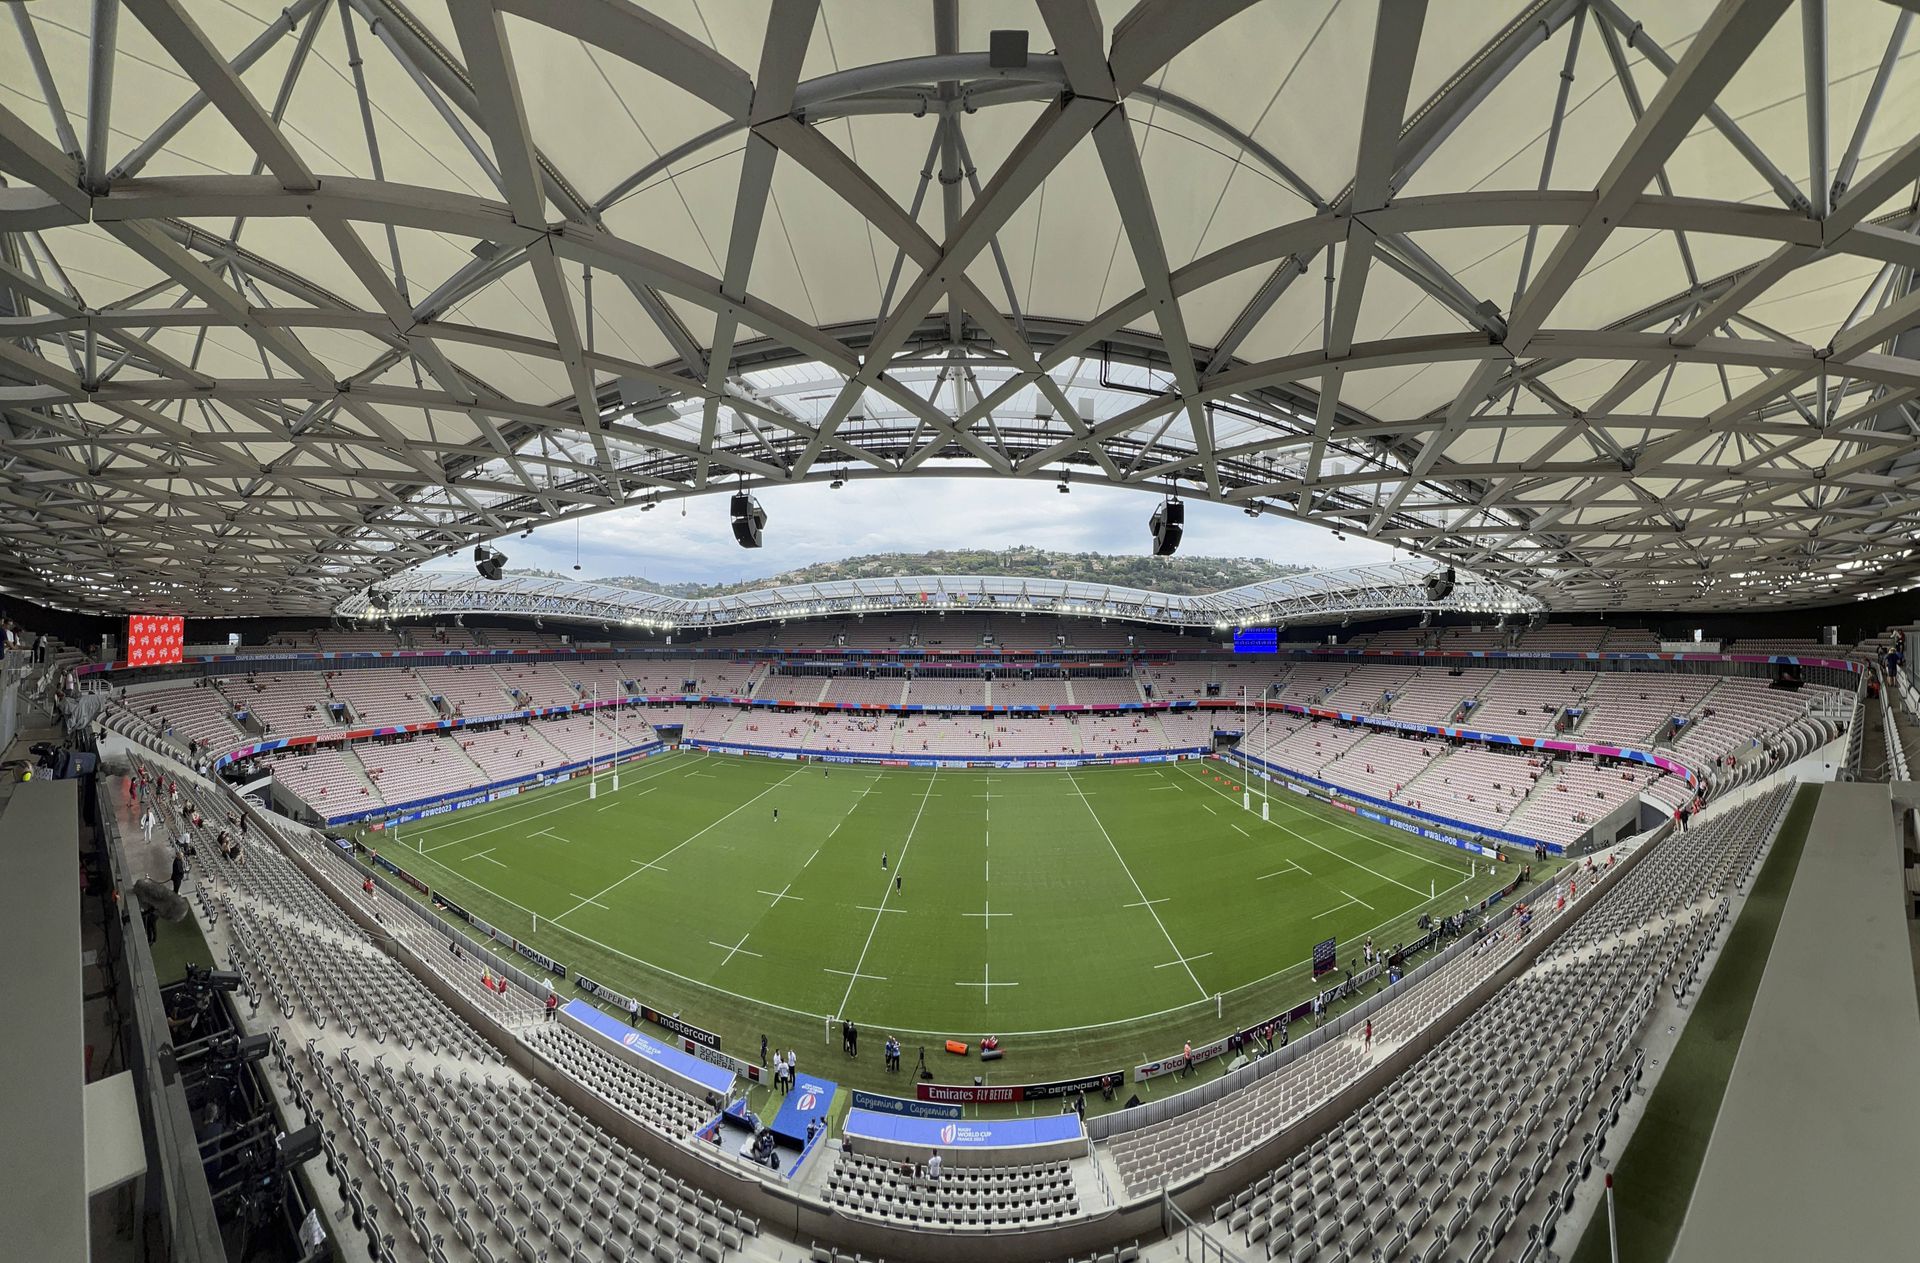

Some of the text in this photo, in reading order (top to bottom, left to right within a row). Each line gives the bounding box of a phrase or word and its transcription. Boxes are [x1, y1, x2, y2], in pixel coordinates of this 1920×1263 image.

[1576, 744, 1590, 752] NICE
[421, 804, 452, 817] #RWC2023
[1389, 819, 1419, 834] #RWC2023
[1424, 830, 1458, 846] #WaLvPOR
[518, 943, 550, 968] PROMAN
[597, 986, 625, 1008] SUPER
[660, 1015, 714, 1045] mastercard
[1249, 1011, 1292, 1039] vivndi
[700, 1046, 735, 1065] SOCIETE
[1163, 1045, 1223, 1071] Totalnergies
[929, 1087, 1013, 1100] Emirates FLY BETTER
[1048, 1080, 1100, 1094] DEFENDER
[856, 1094, 949, 1118] Capgemini Capgemini
